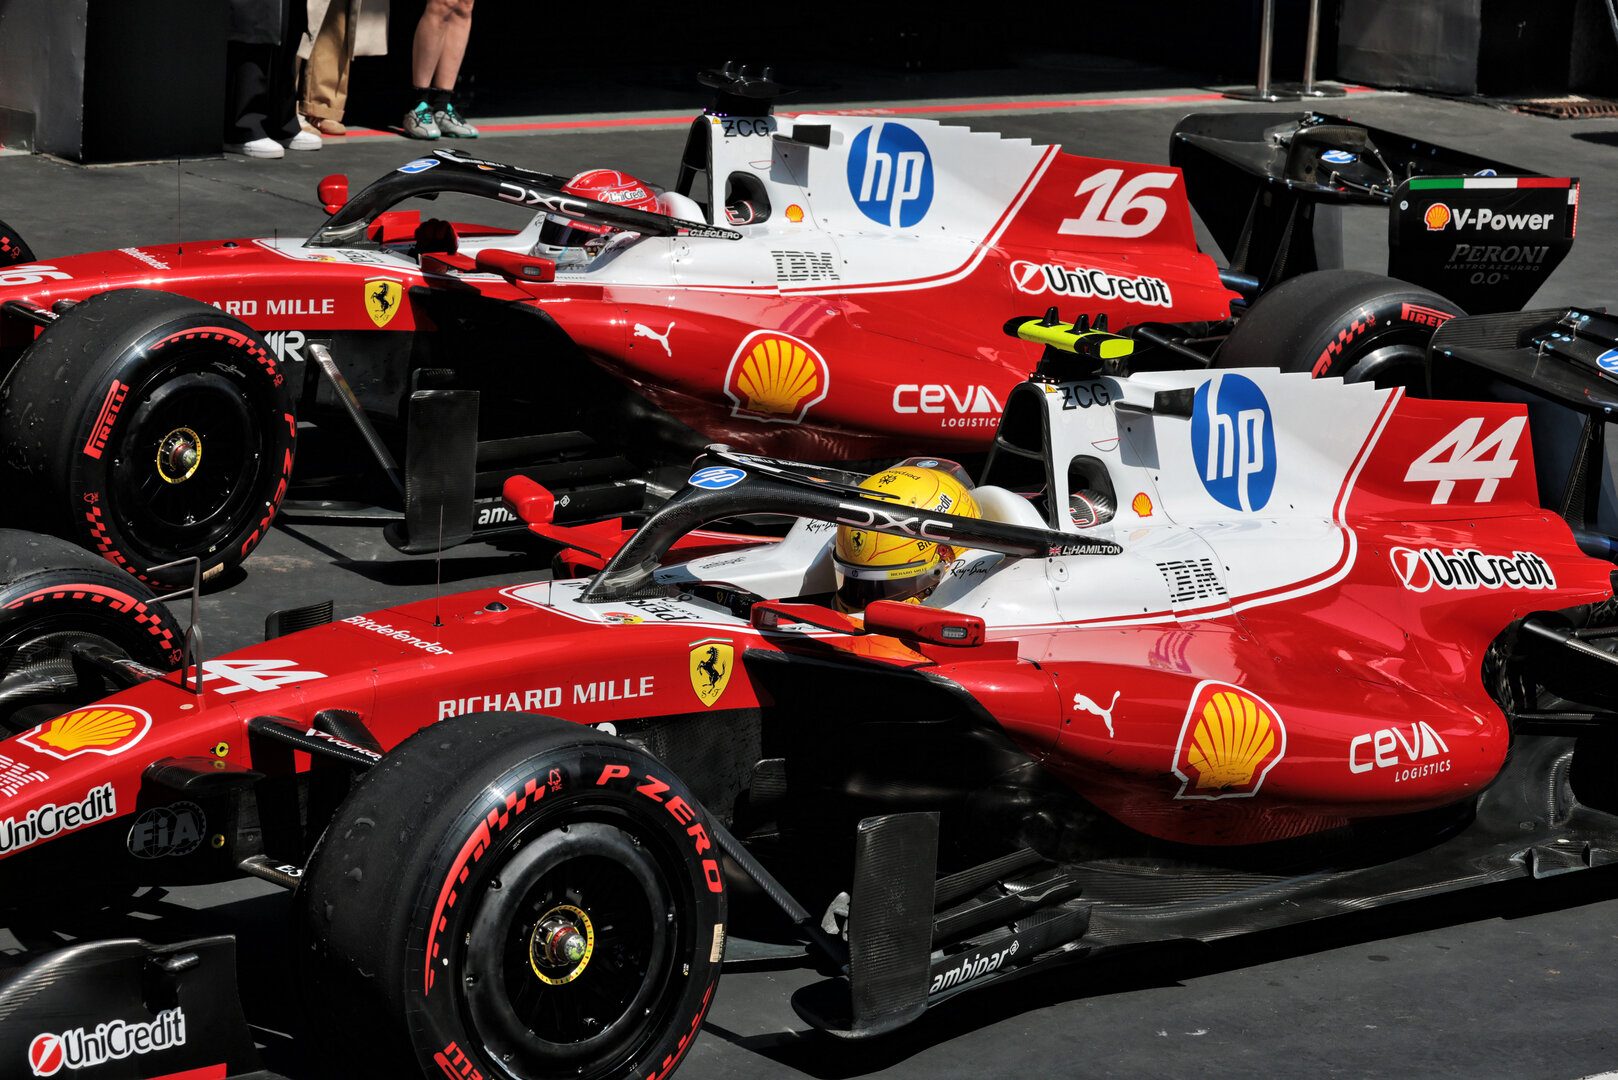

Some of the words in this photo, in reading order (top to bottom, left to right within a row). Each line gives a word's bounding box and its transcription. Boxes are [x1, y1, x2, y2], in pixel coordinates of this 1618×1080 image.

[722, 117, 771, 138] ZCG
[857, 121, 928, 229] hp
[498, 183, 588, 217] DXC
[1057, 168, 1179, 239] 16
[690, 229, 740, 239] C.LECLERC
[1451, 208, 1554, 231] V-Power
[770, 250, 841, 281] IBM
[1448, 244, 1550, 263] PERONI
[1043, 264, 1172, 307] UniCredit
[266, 298, 335, 315] MILLE
[1056, 383, 1111, 411] ZCG
[84, 378, 130, 460] PIRELLI
[1206, 373, 1267, 513] hp
[1403, 416, 1528, 505] 44
[836, 503, 953, 541] DXC
[1062, 545, 1121, 555] L.HAMILTON
[1422, 549, 1556, 588] UniCredit
[1156, 558, 1228, 603] IBM
[344, 616, 453, 656] Bitdefender
[187, 659, 329, 695] 44
[438, 687, 562, 724] RICHARD
[573, 676, 655, 705] MILLE
[1394, 760, 1452, 783] LOGISTICS
[597, 764, 630, 786] P
[636, 774, 723, 894] ZERO
[63, 1009, 185, 1067] UniCredit
